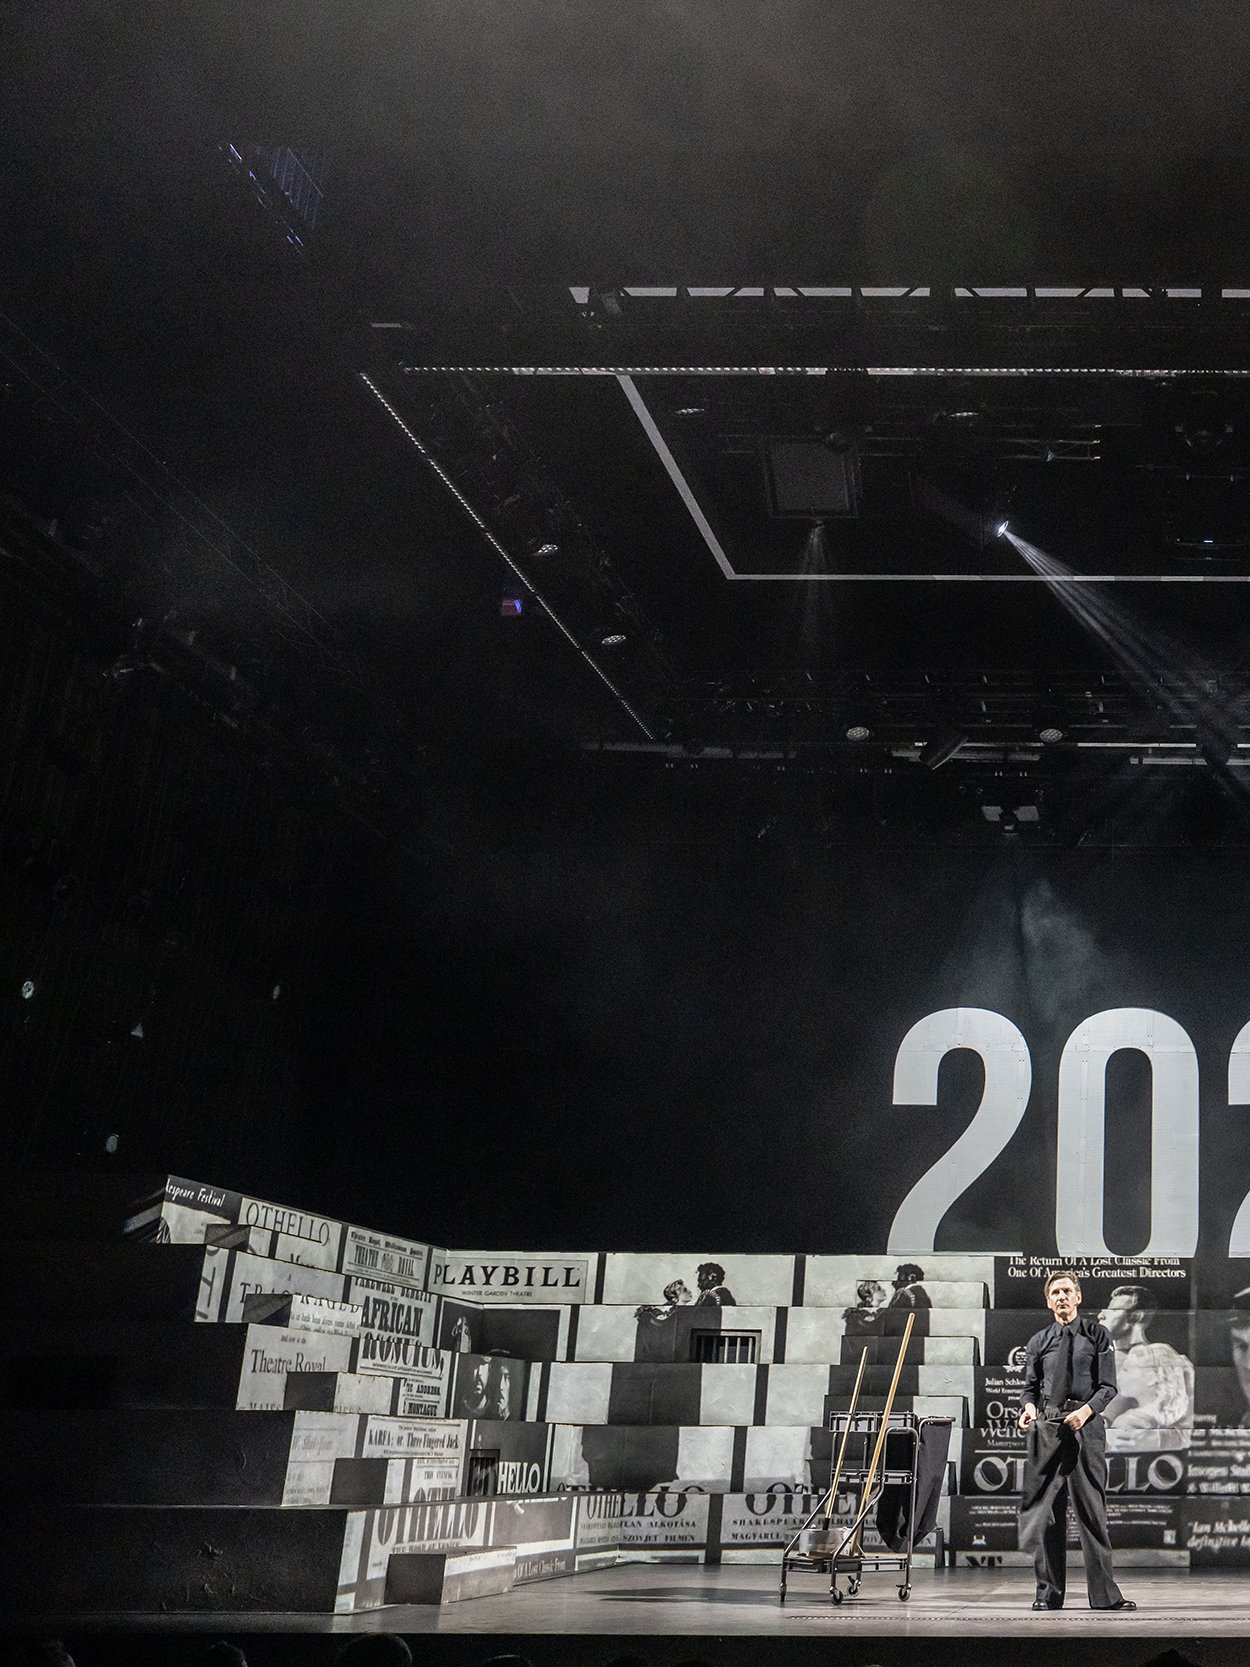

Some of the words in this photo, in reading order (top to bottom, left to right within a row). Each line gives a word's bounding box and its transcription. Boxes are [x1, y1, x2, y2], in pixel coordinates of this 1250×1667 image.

[197, 1187, 226, 1208] Festival
[1007, 1267, 1027, 1278] One
[1029, 1267, 1043, 1278] Of
[1092, 1267, 1137, 1278] Greatest
[1139, 1267, 1187, 1278] Directors
[1030, 1257, 1063, 1266] Return
[434, 1264, 582, 1287] PLAYBILL
[361, 1294, 423, 1338] AFRICAN
[250, 1348, 291, 1374] Theatre
[986, 1400, 1021, 1419] Ors
[973, 1454, 1184, 1494] OTLLO
